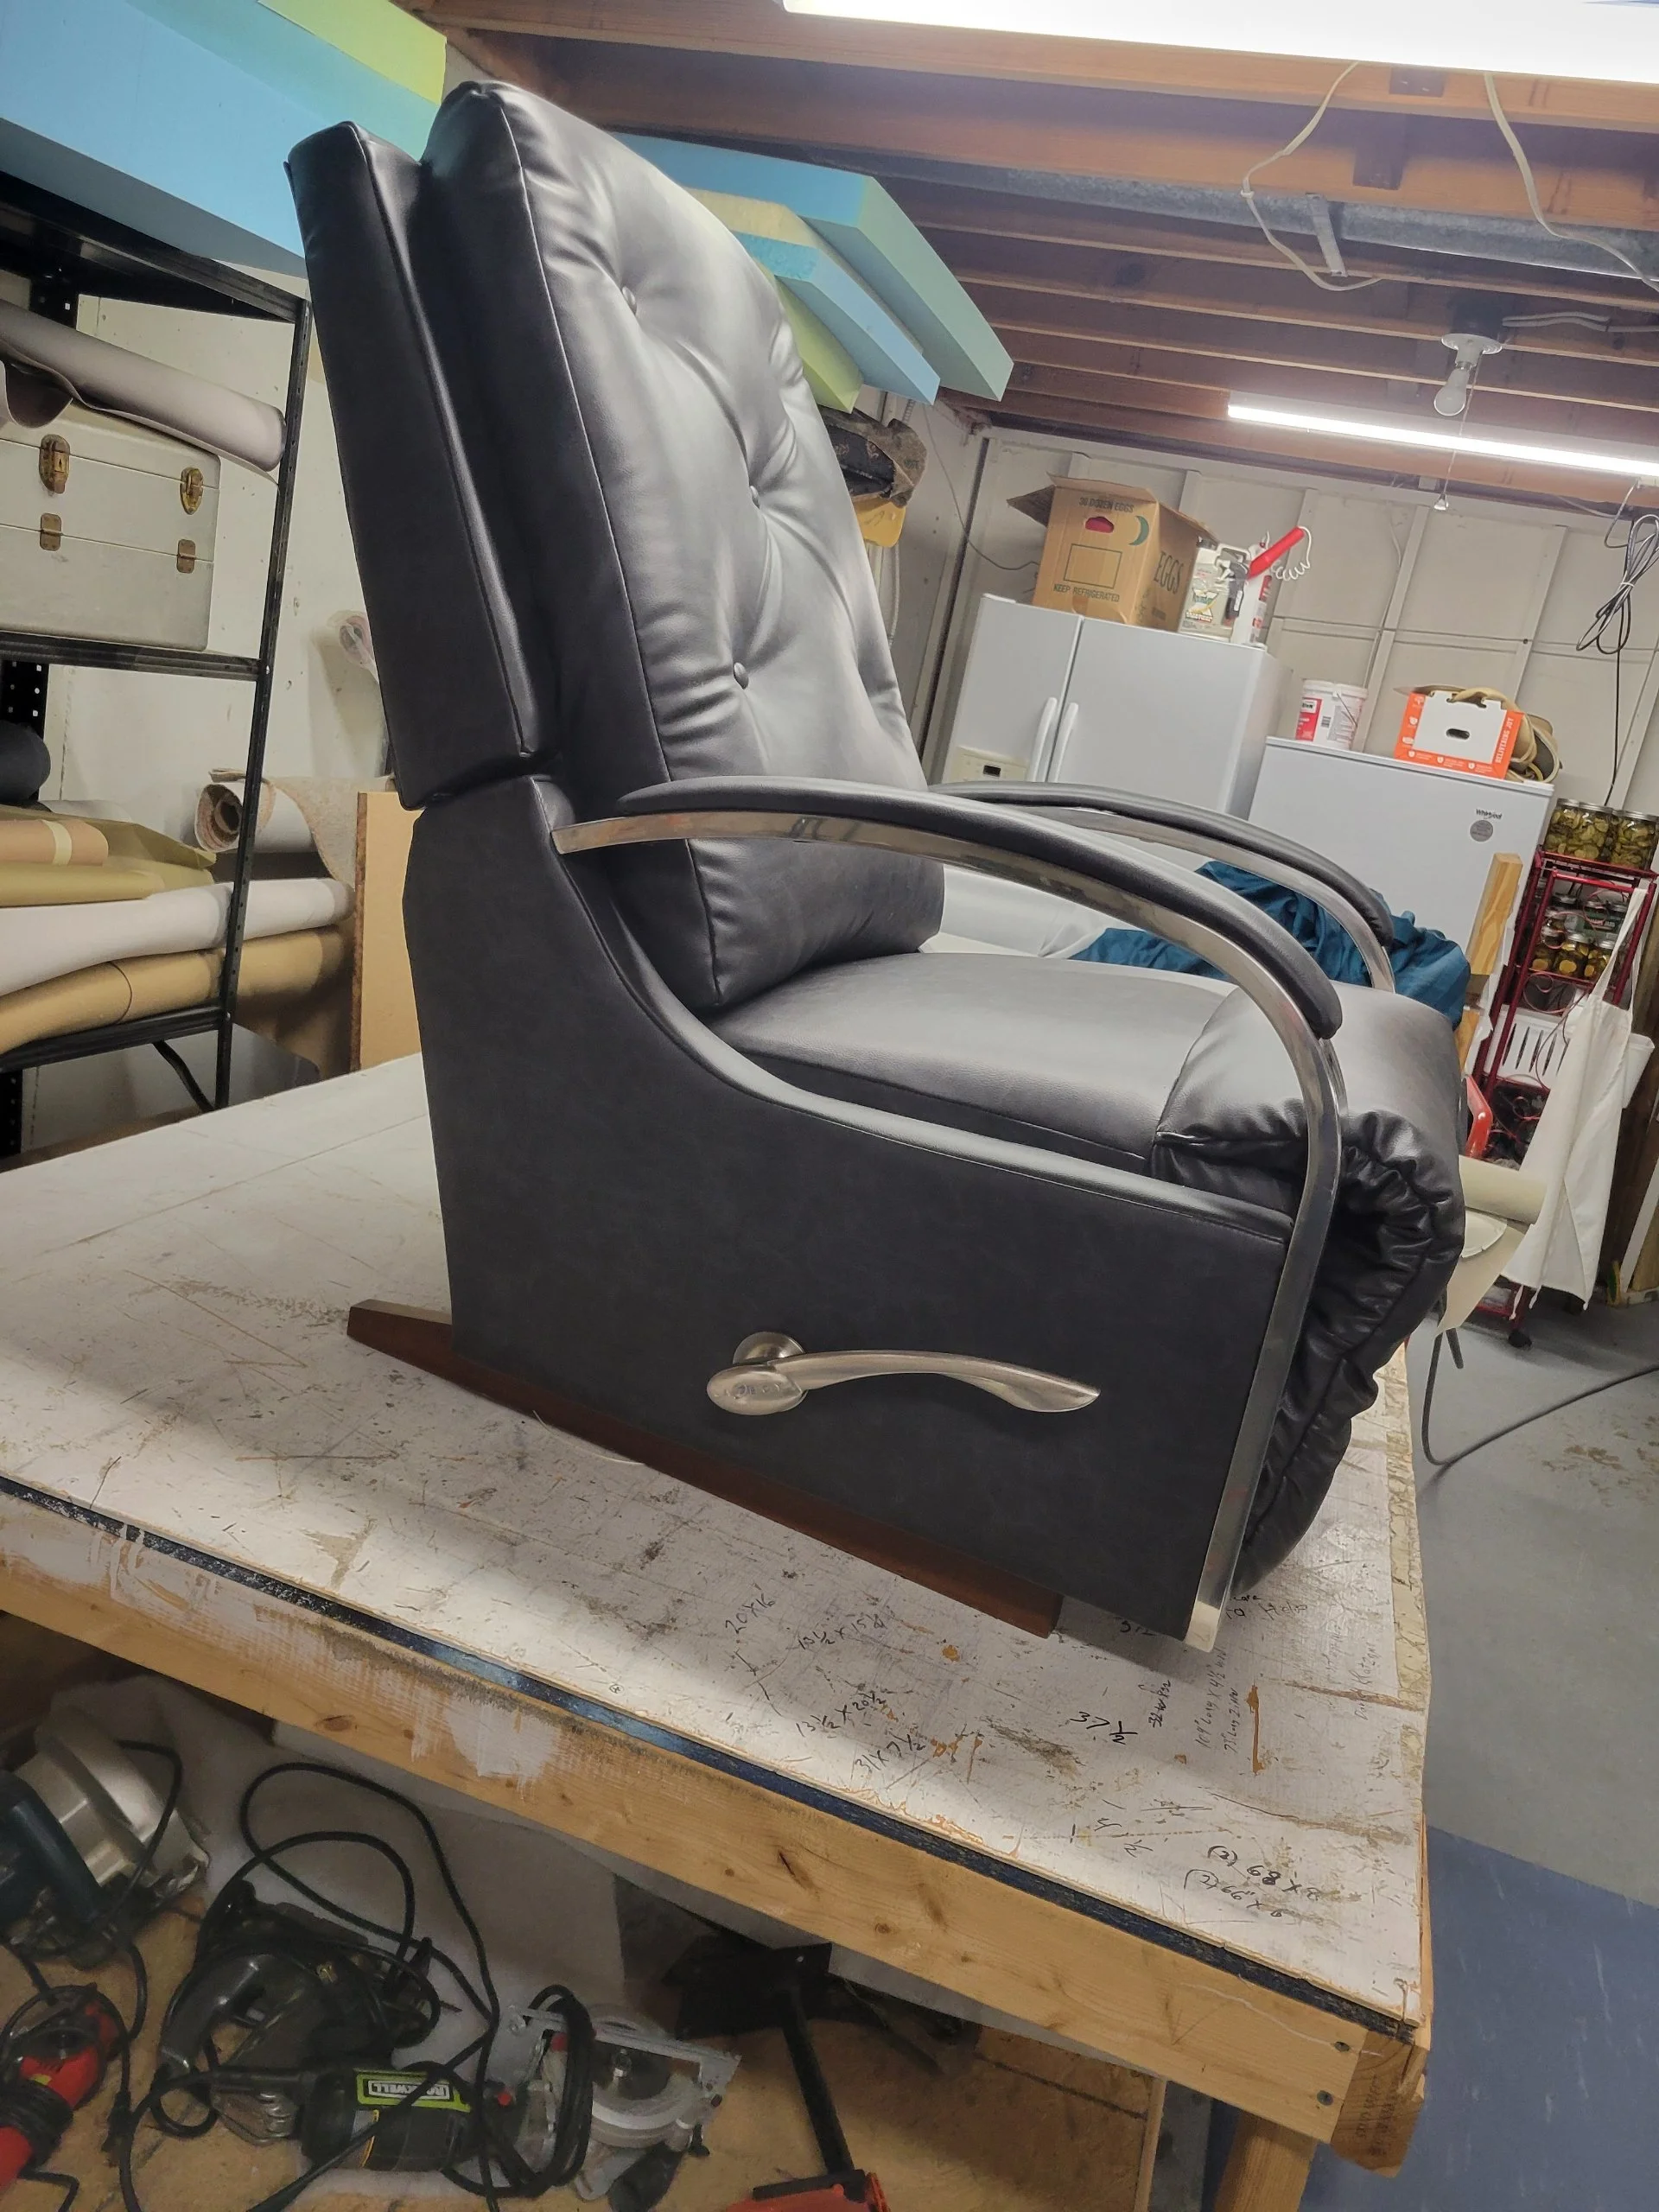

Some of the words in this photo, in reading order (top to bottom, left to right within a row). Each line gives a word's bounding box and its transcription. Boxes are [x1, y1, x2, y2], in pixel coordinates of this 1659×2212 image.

[1090, 498, 1113, 509] DOZEN
[1114, 502, 1135, 512] EGGS
[1154, 550, 1184, 594] EGGS
[1053, 583, 1071, 594] KEEP
[1072, 587, 1120, 602] REFRIGERATED
[373, 2083, 446, 2096] ROKWELL
